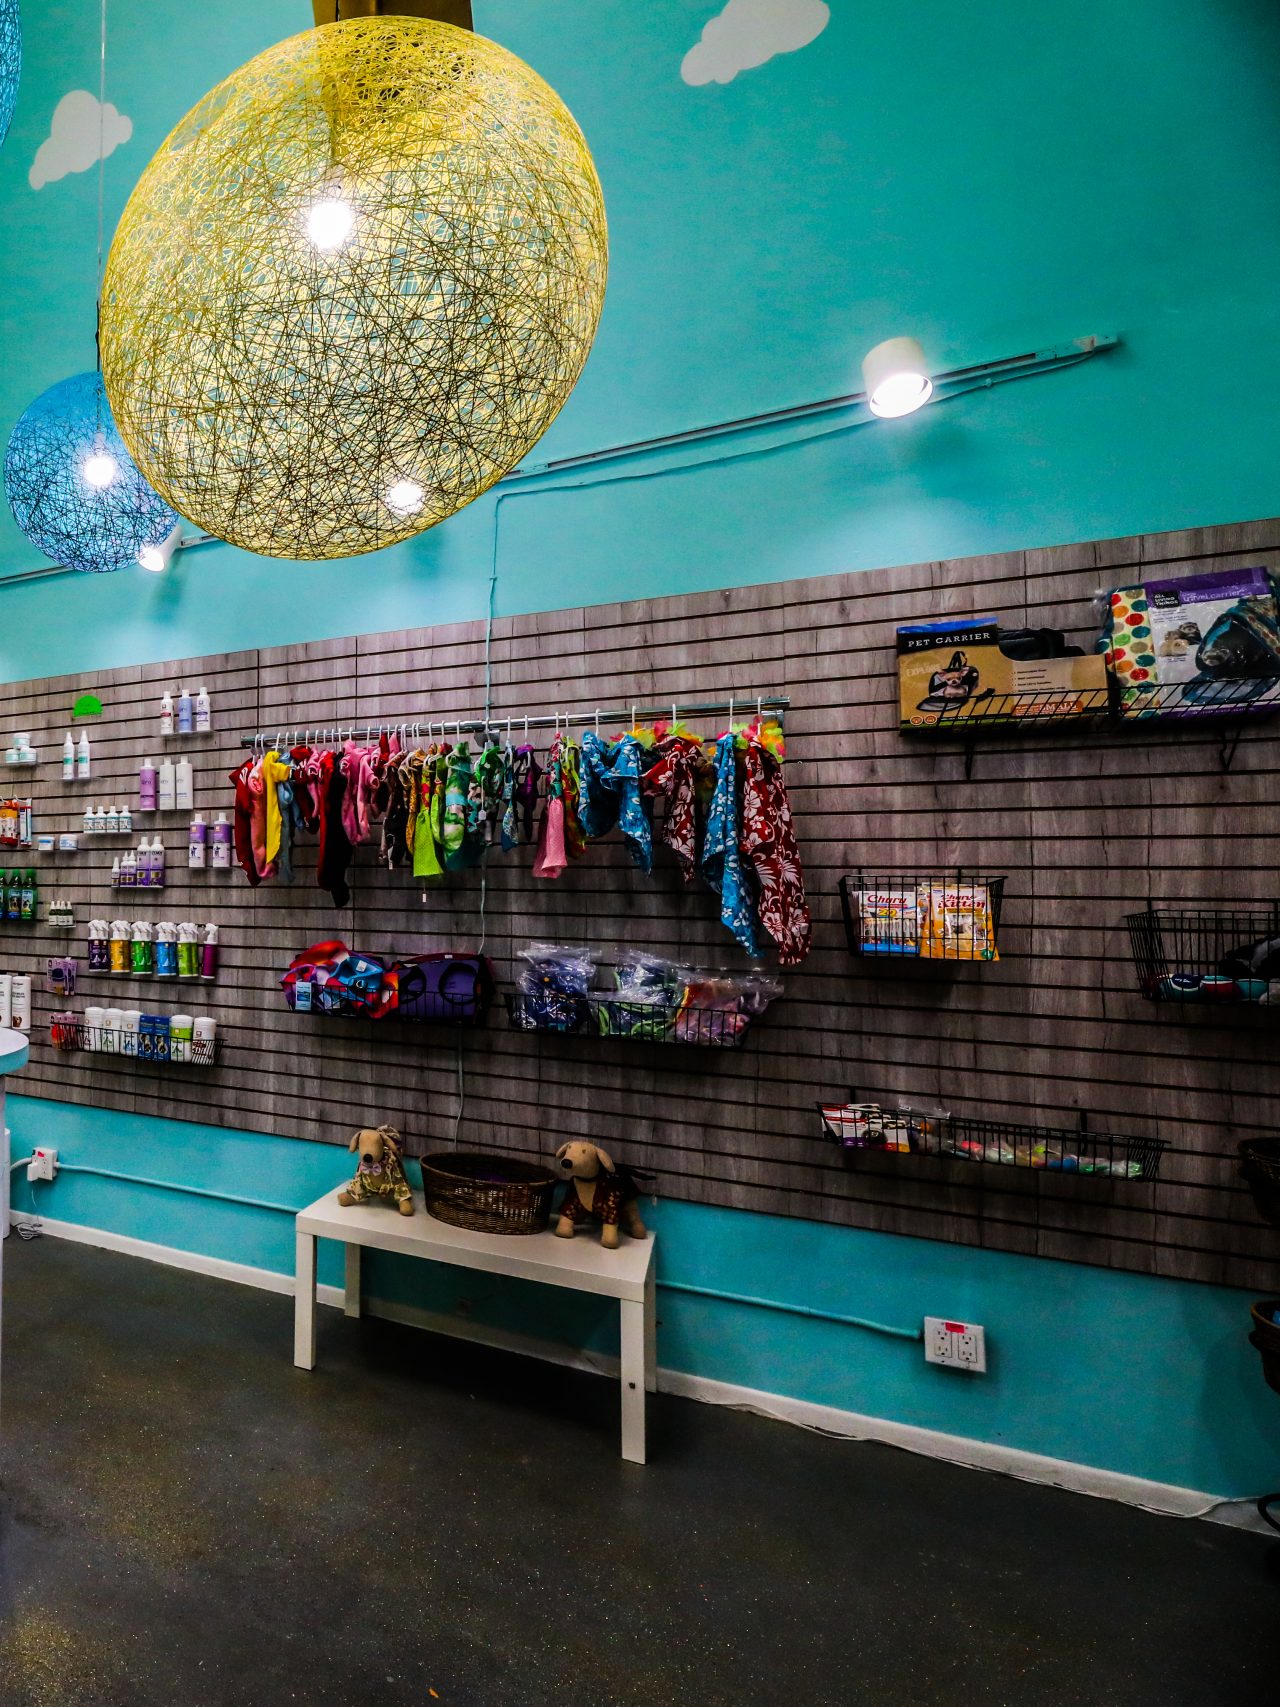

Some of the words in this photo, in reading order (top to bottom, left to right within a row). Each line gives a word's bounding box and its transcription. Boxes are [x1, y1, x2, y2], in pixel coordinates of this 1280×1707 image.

[1210, 590, 1240, 599] carrier
[907, 638, 931, 648] PET
[935, 632, 991, 645] CARRIER
[1039, 702, 1077, 711] SMALL
[867, 894, 907, 904] Churu
